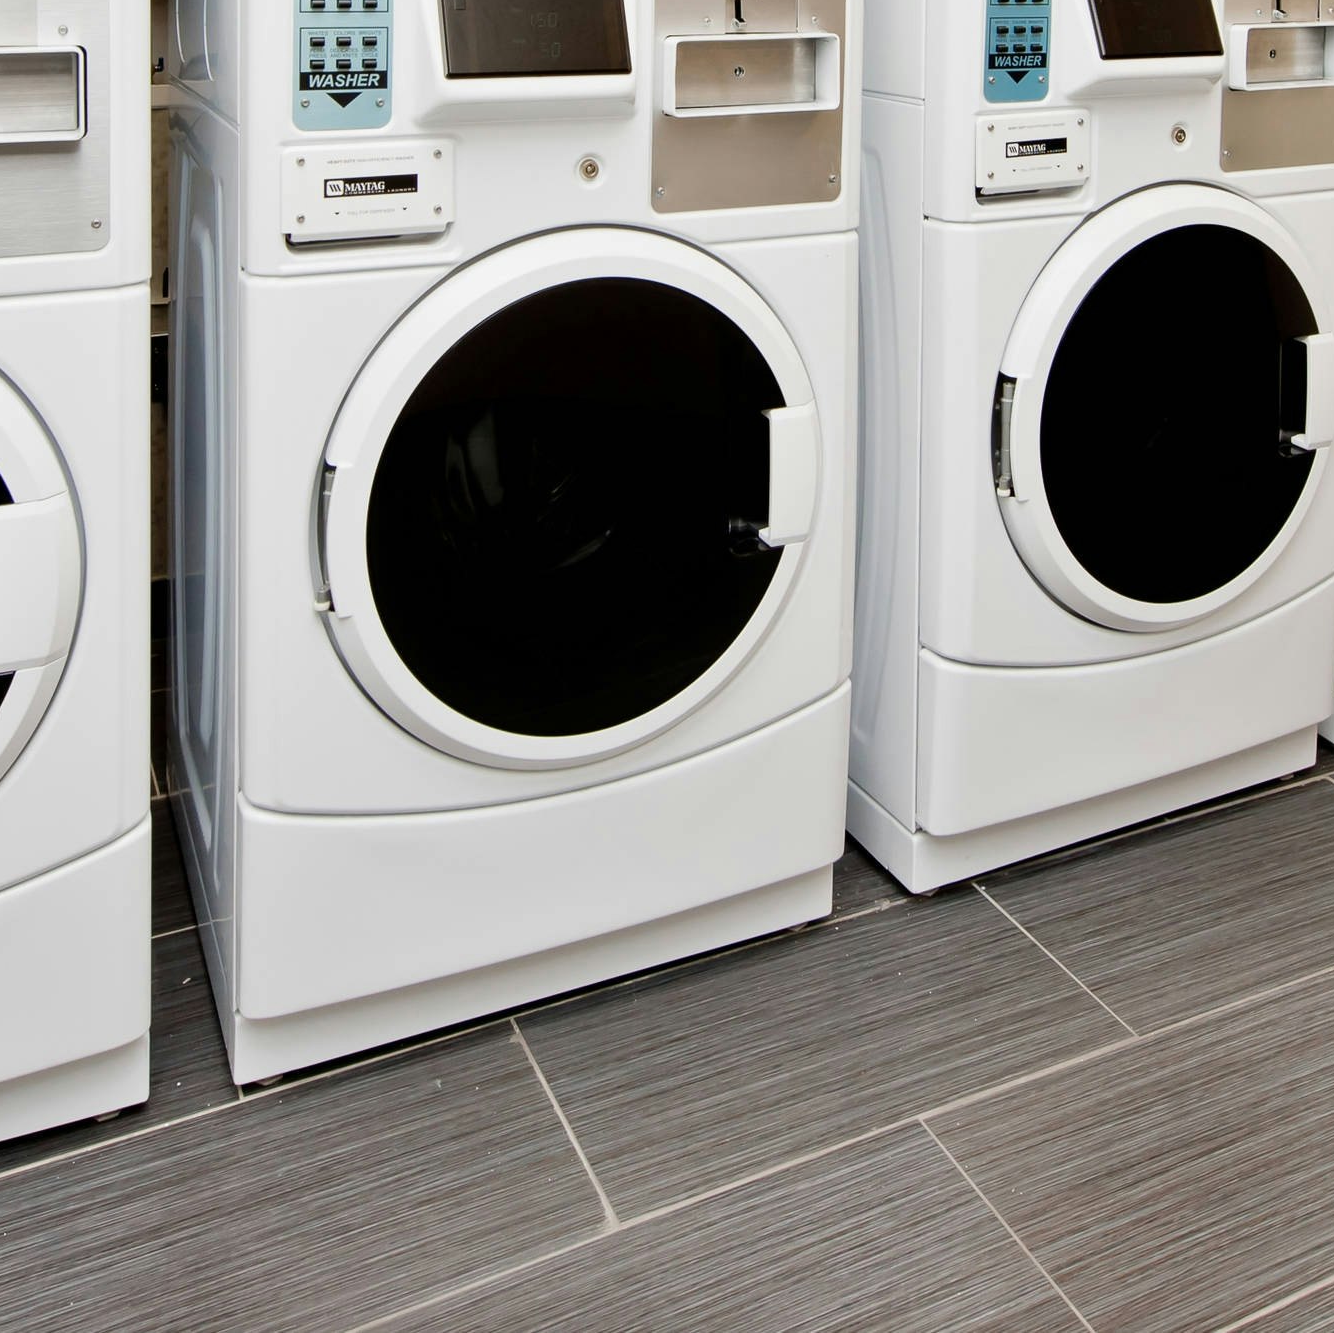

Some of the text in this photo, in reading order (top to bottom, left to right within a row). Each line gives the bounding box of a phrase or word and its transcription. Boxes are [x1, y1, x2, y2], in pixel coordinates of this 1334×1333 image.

[994, 55, 1042, 67] WASHER
[308, 73, 380, 88] WASHER
[1019, 144, 1047, 154] MAYTAG
[344, 181, 386, 193] MAYTAG
